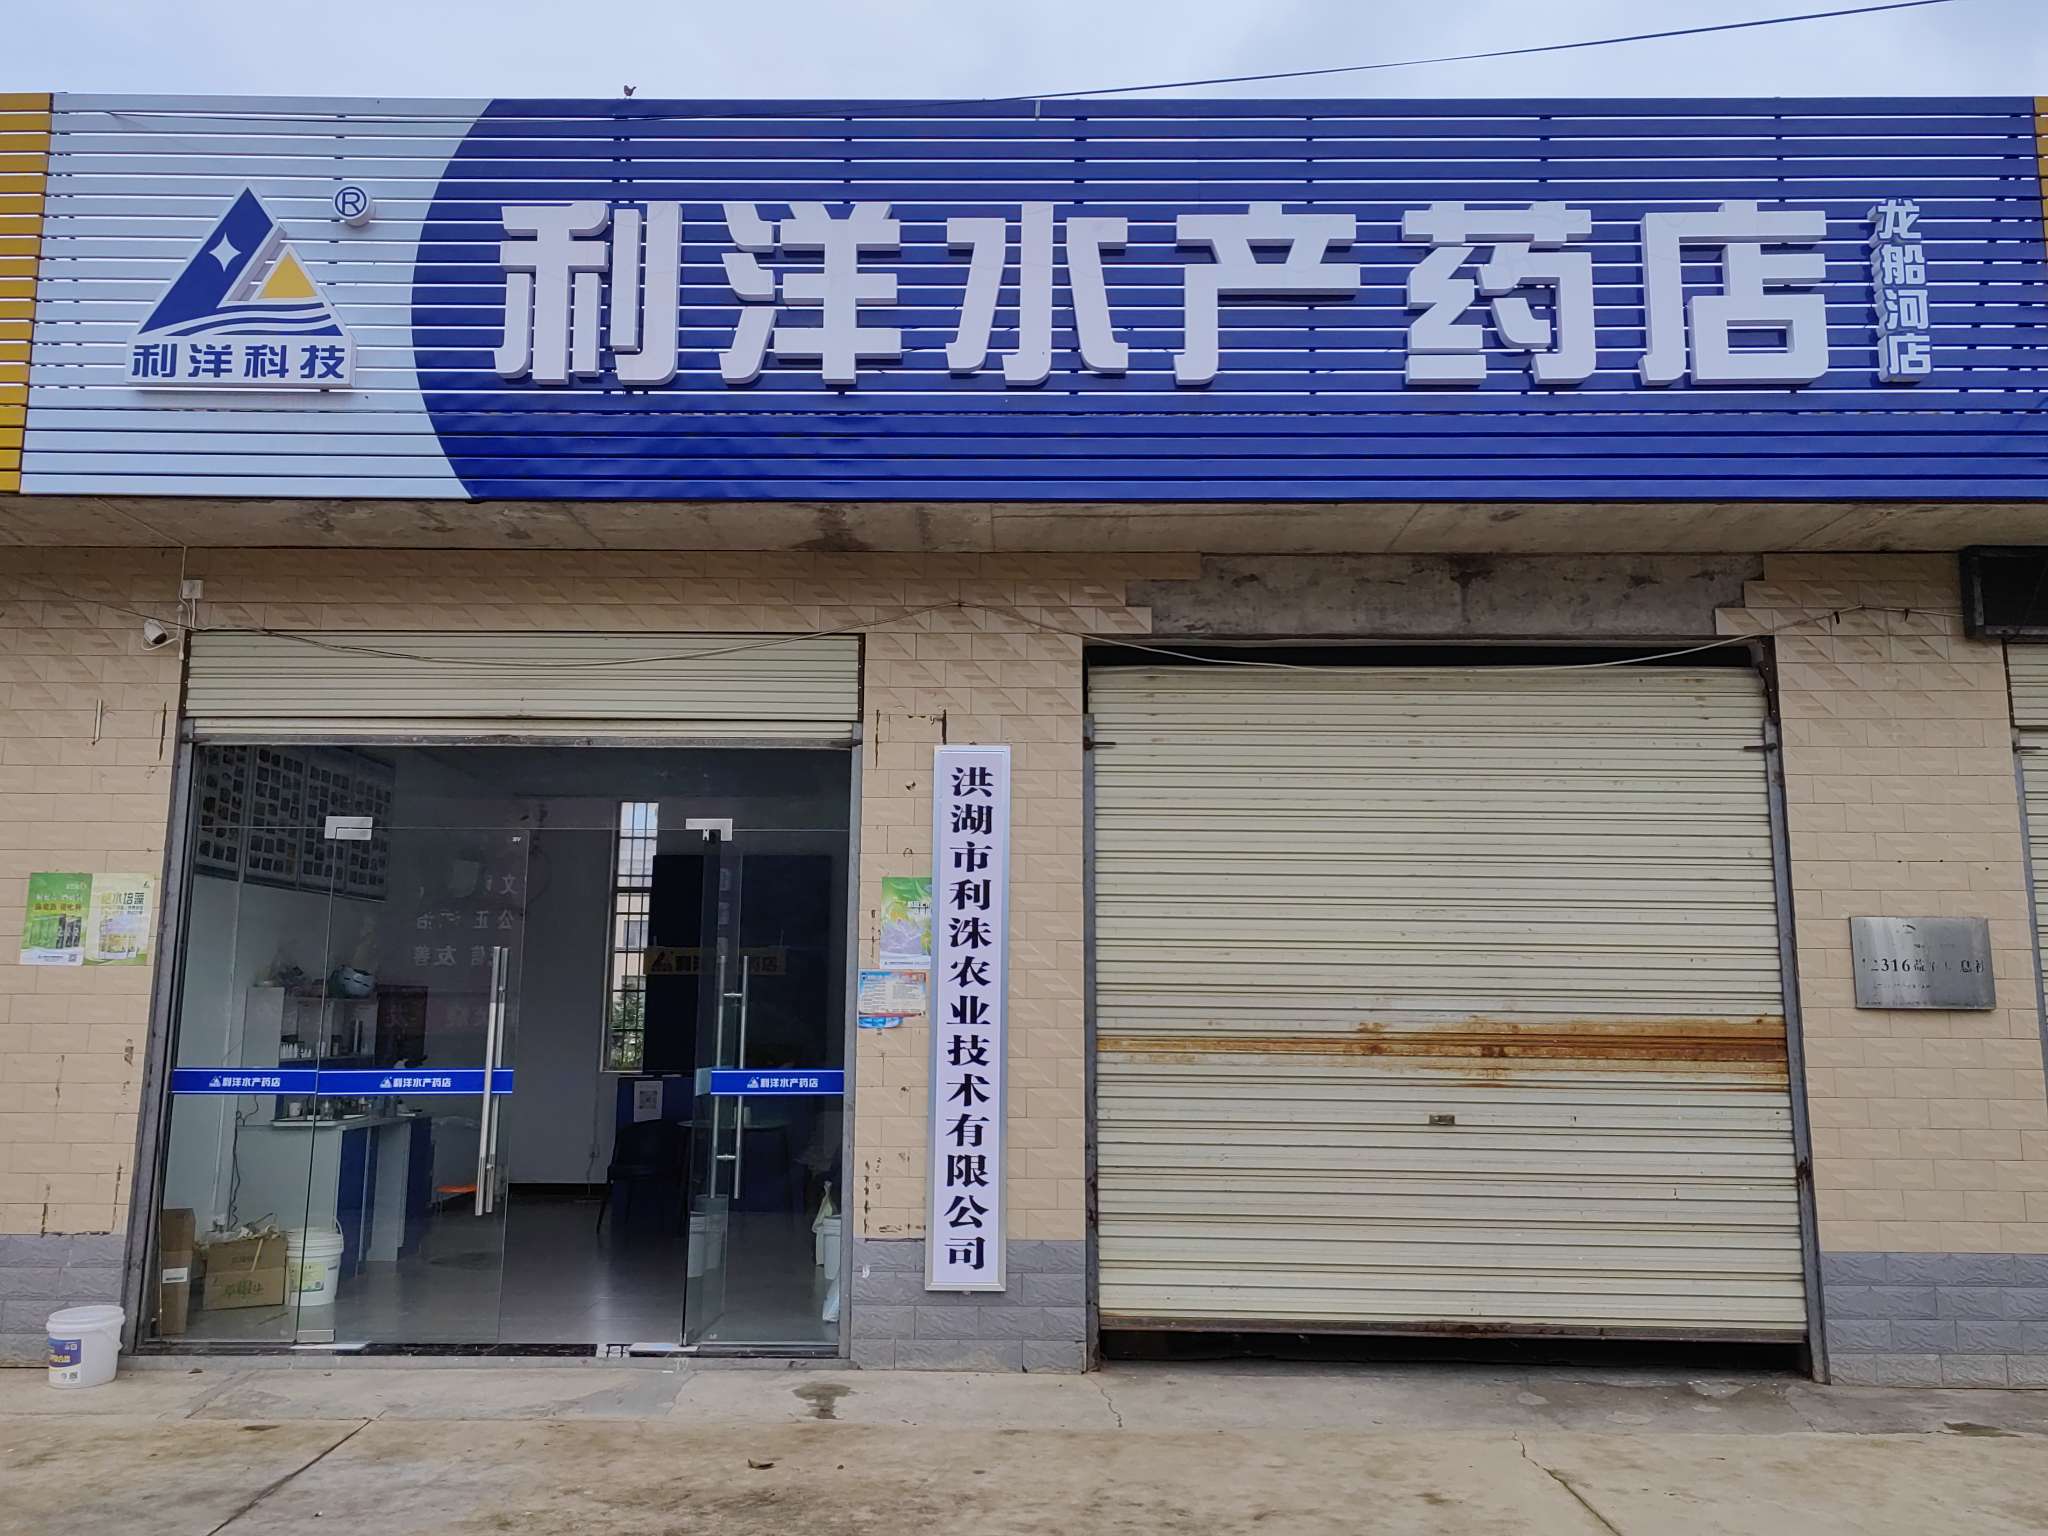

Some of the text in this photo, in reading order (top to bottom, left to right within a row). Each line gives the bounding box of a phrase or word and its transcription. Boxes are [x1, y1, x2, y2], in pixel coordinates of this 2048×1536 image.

[132, 343, 346, 379] 利洋科技
[494, 200, 1830, 386] 利洋水产药店
[1873, 198, 1932, 377] 龙船河店
[944, 766, 995, 1270] 洪湖市利洙农业技术有限公司
